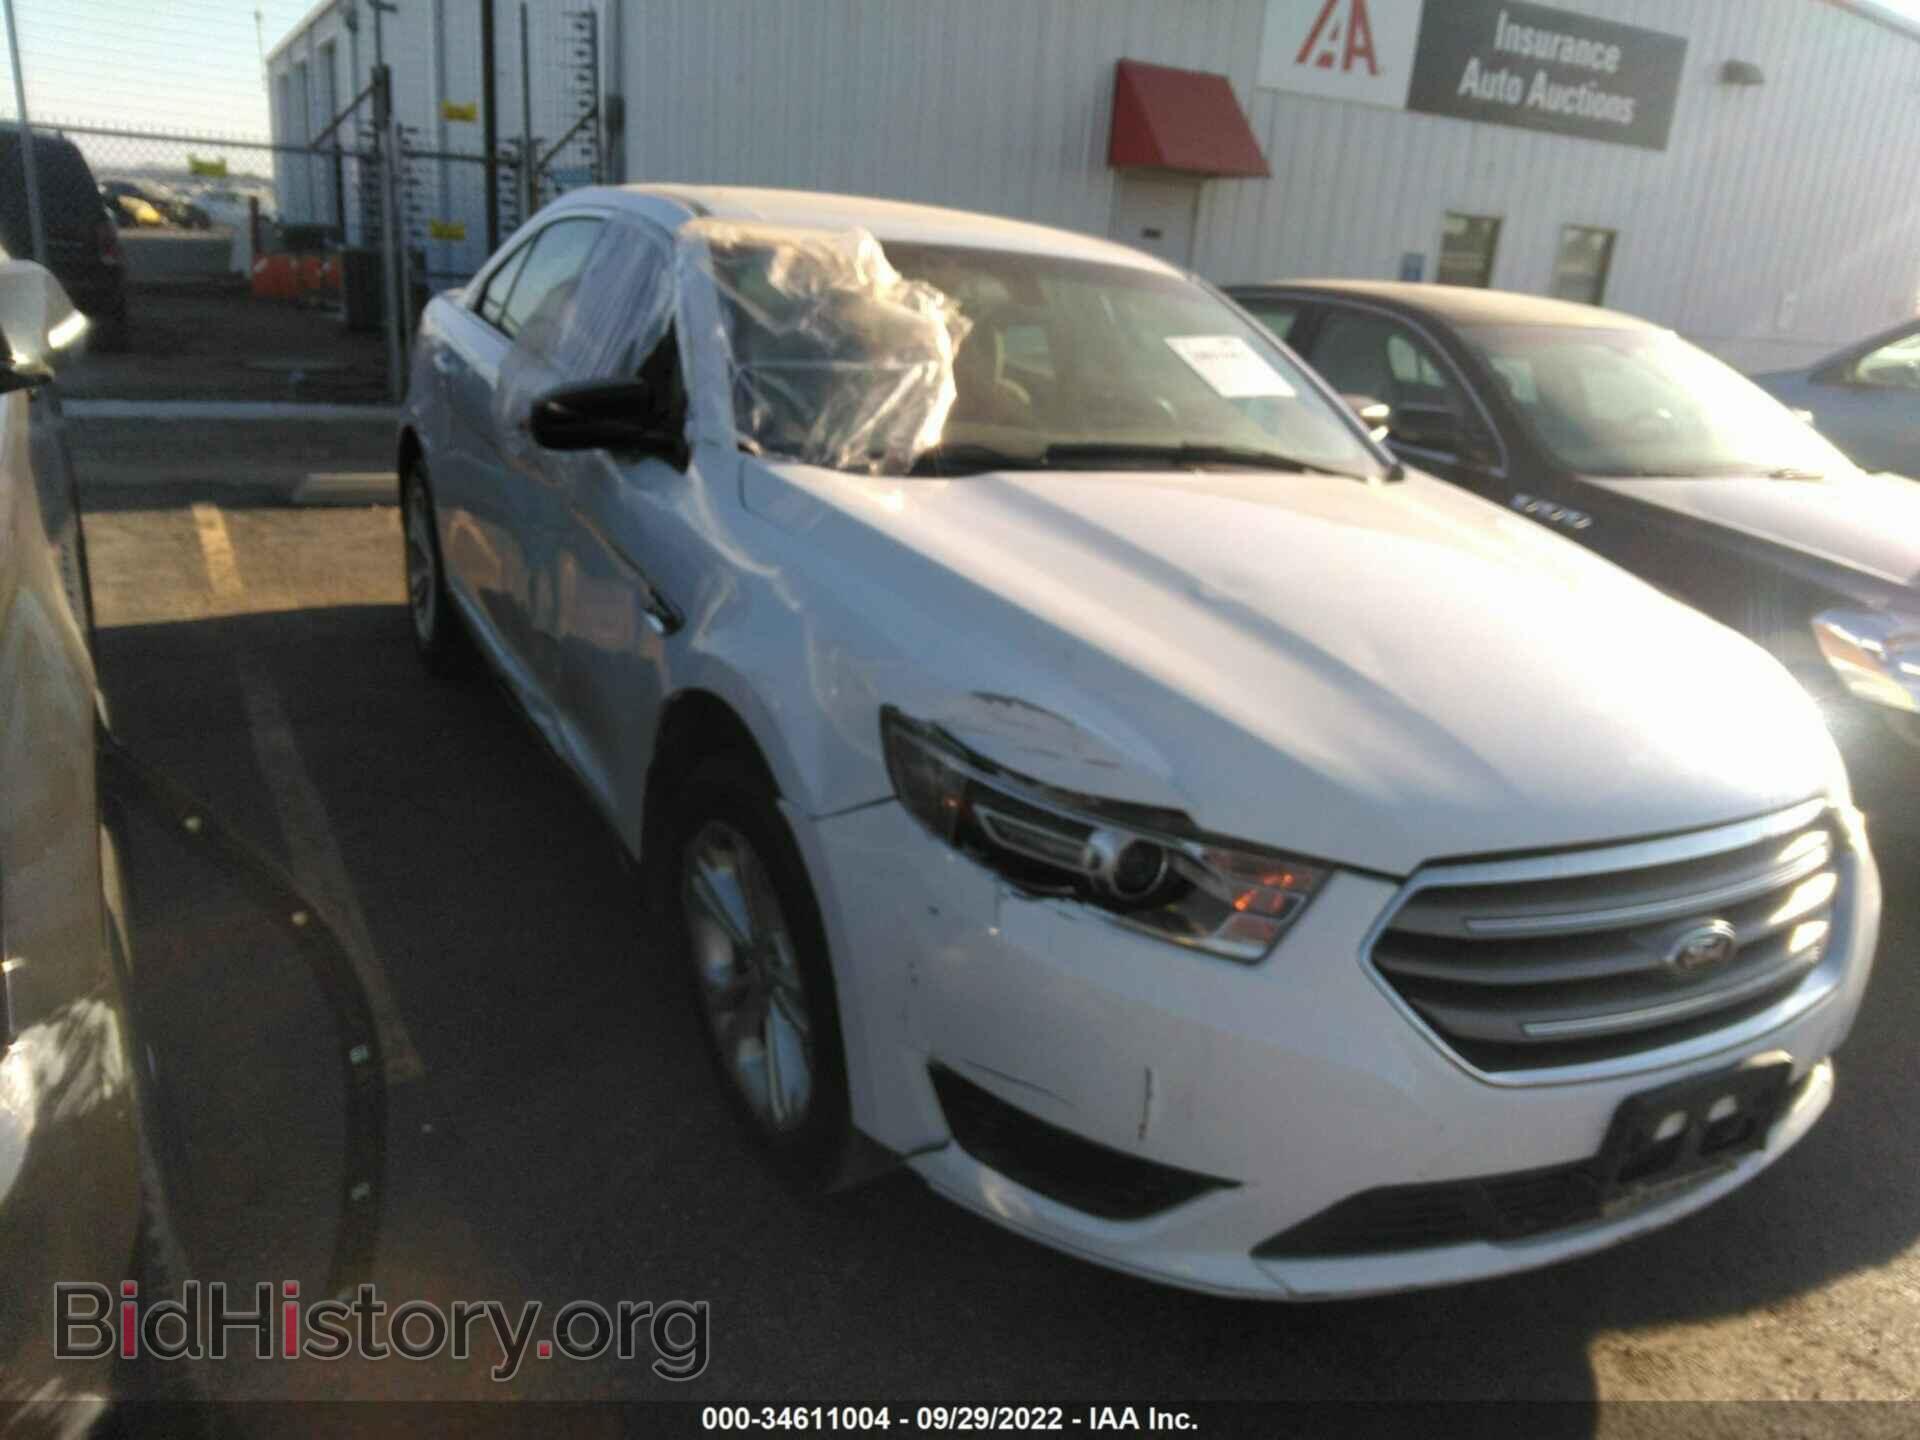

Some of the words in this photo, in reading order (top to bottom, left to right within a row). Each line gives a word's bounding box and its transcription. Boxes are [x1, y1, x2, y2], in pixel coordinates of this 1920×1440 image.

[1495, 11, 1622, 73] Insurance
[1458, 57, 1522, 105] Auto
[1527, 69, 1637, 125] Auctions
